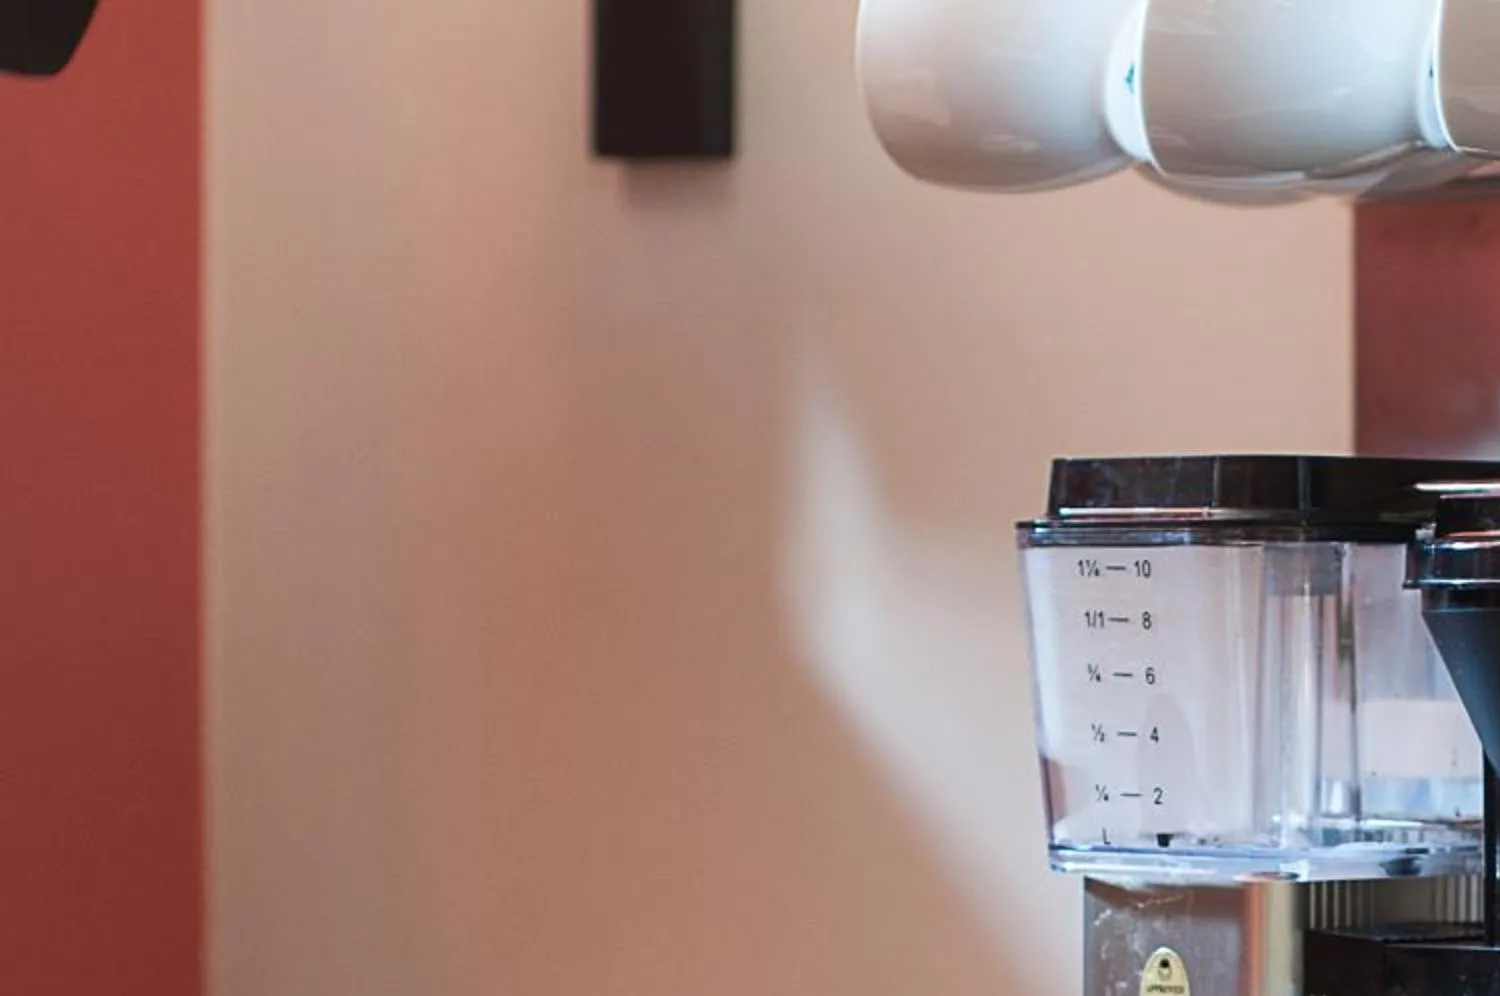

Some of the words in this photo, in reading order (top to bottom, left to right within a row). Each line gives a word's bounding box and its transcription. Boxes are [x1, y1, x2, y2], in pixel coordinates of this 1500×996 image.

[1134, 559, 1152, 578] 10
[1142, 611, 1153, 630] 8
[1145, 666, 1156, 685] 6
[1149, 725, 1160, 744] 4
[1153, 786, 1164, 805] 2
